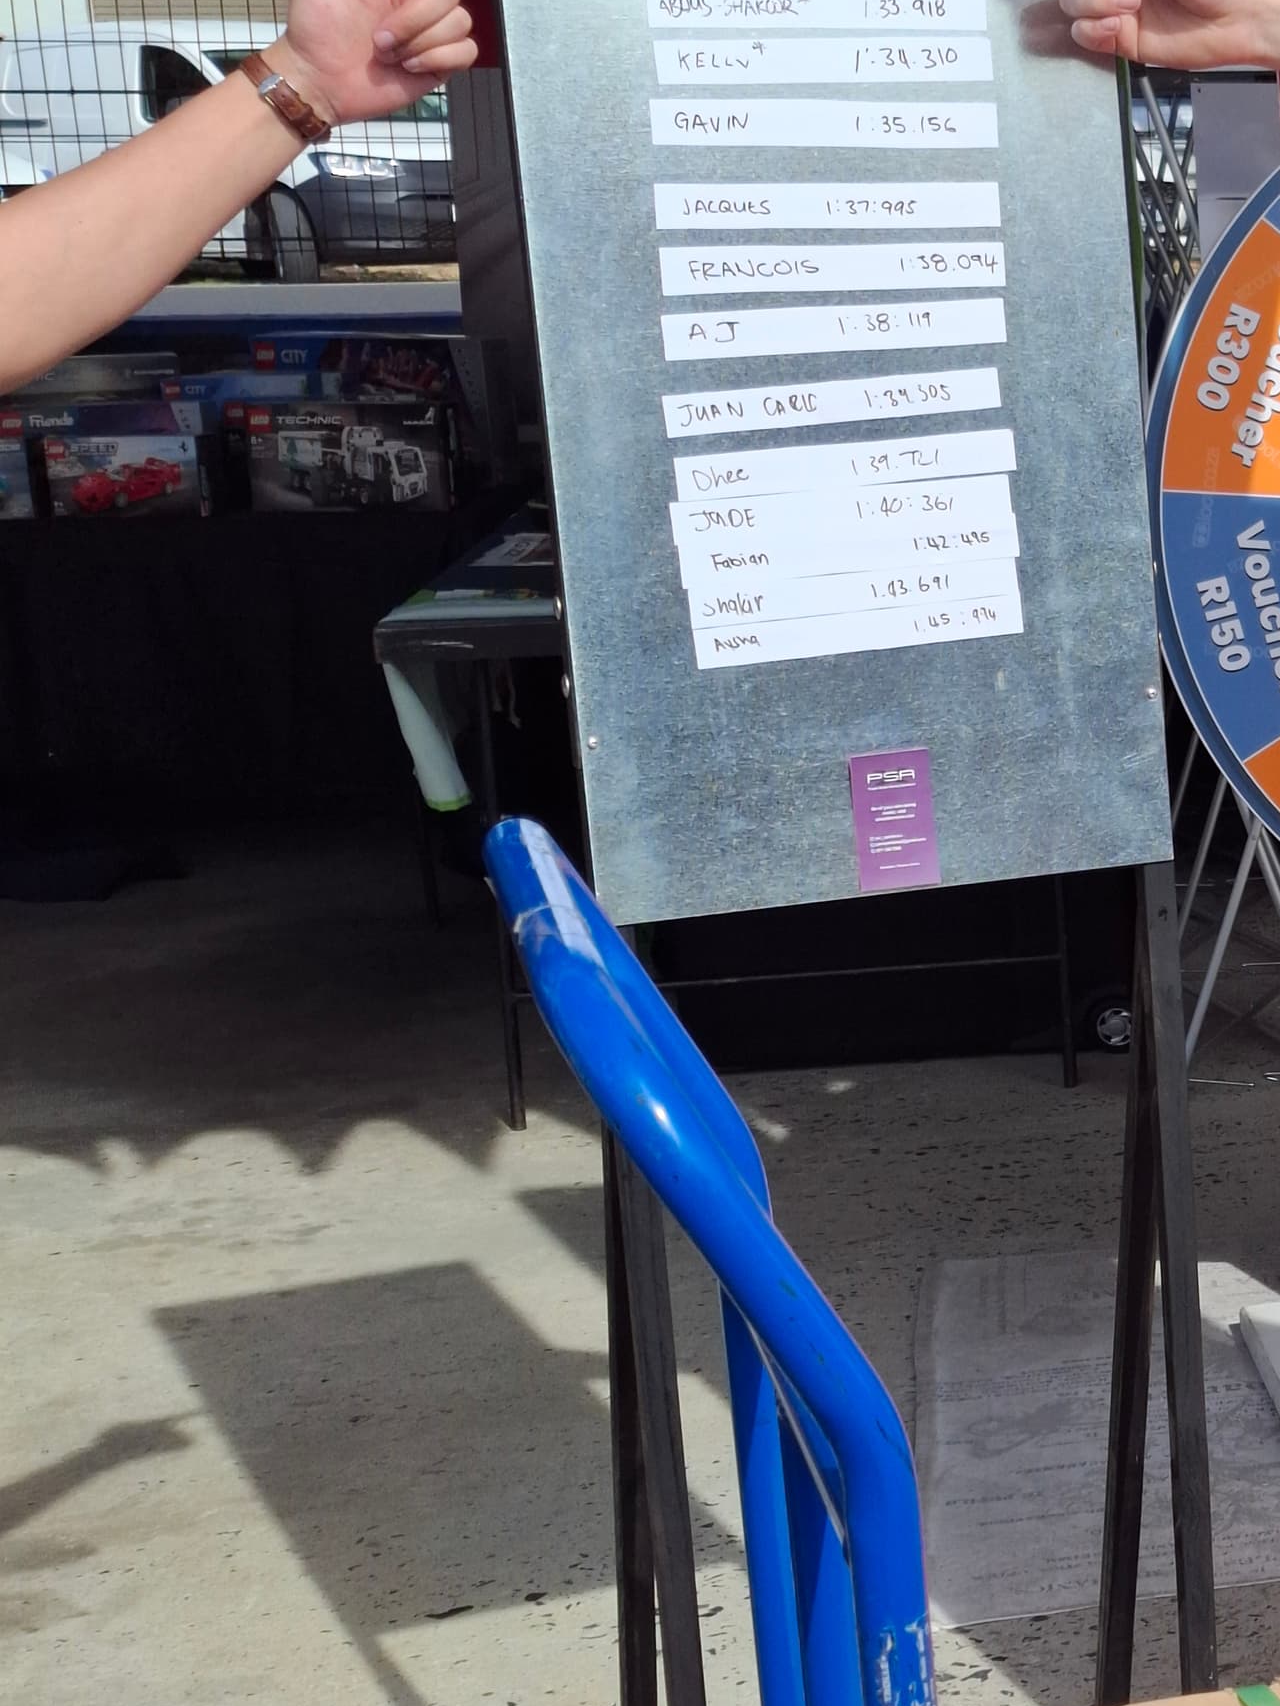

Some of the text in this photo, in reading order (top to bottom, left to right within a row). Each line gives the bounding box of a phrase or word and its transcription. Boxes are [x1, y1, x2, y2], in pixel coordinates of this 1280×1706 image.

[674, 112, 749, 134] GAVIN
[682, 198, 771, 216] JACQUES
[688, 259, 820, 281] FRANCOIS
[1197, 302, 1262, 411] R300
[711, 552, 770, 573] Fabian
[1196, 576, 1252, 673] R150
